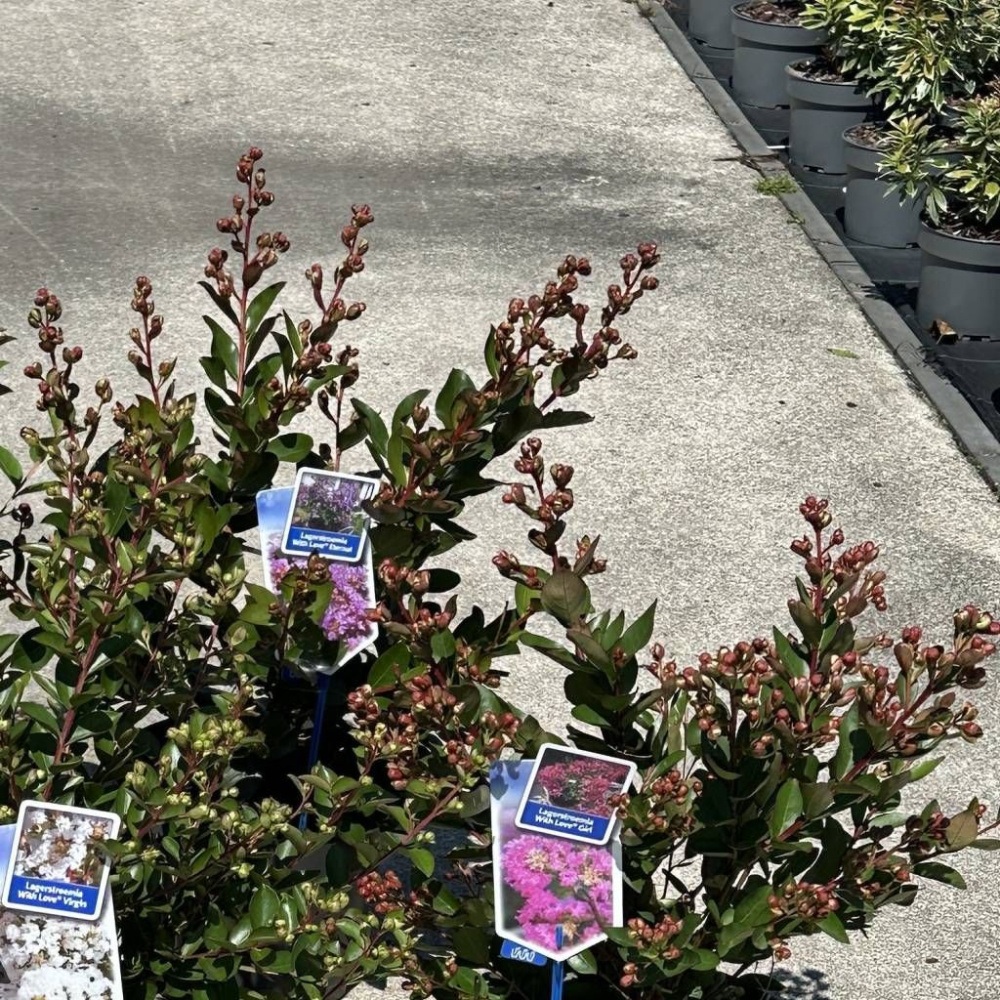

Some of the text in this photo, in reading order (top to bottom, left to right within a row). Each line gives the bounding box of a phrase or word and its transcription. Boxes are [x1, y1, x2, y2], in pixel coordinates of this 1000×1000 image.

[535, 814, 553, 824] With
[18, 890, 37, 900] With
[63, 897, 87, 908] Virgin
